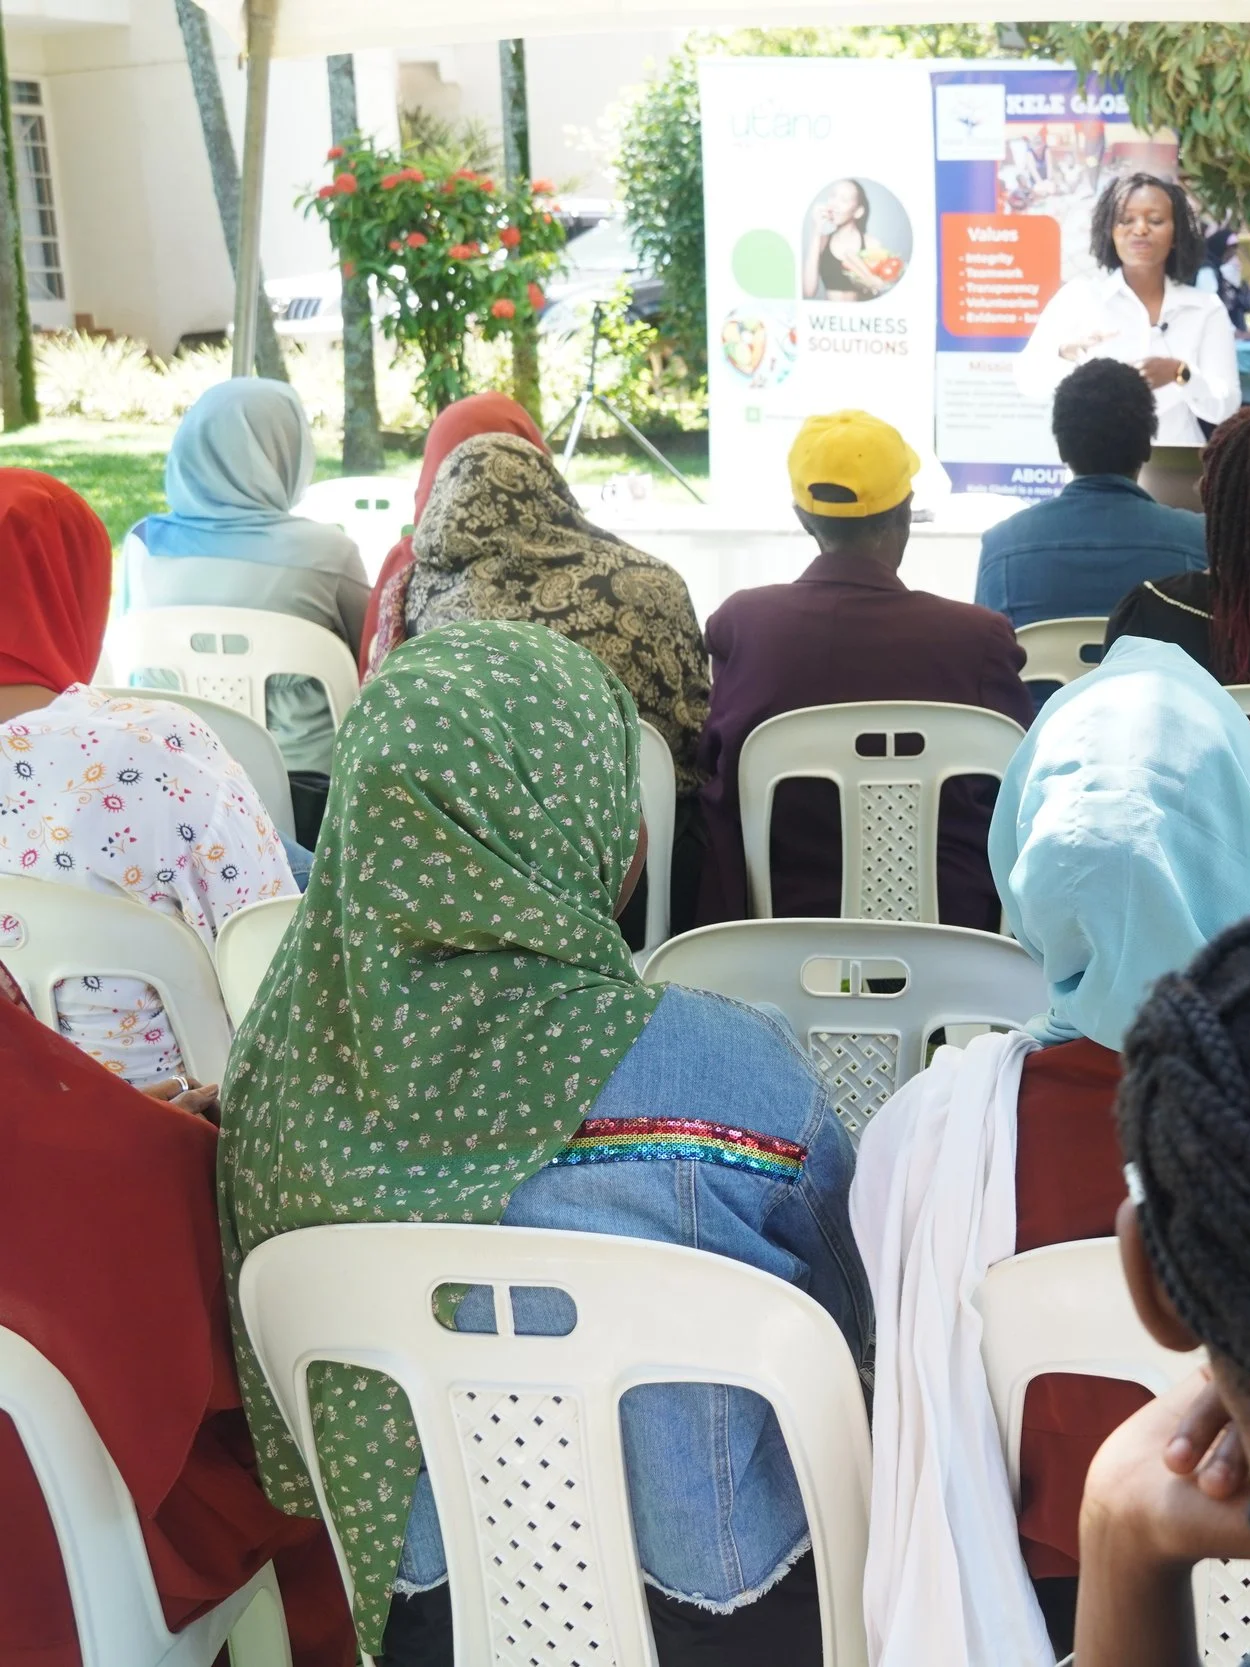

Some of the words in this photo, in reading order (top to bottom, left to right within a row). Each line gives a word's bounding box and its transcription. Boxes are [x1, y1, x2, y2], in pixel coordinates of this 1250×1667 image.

[1005, 93, 1065, 115] KELE
[1070, 93, 1130, 115] GLOB
[966, 226, 1020, 242] Values
[965, 253, 1015, 267] Integrity
[965, 267, 1024, 279] Teamwork
[965, 282, 1040, 296] Transparency
[807, 314, 909, 335] WELLNESS
[965, 311, 1017, 323] Evidence
[807, 336, 910, 356] SOLUTIONS
[1011, 467, 1067, 484] ABOUT
